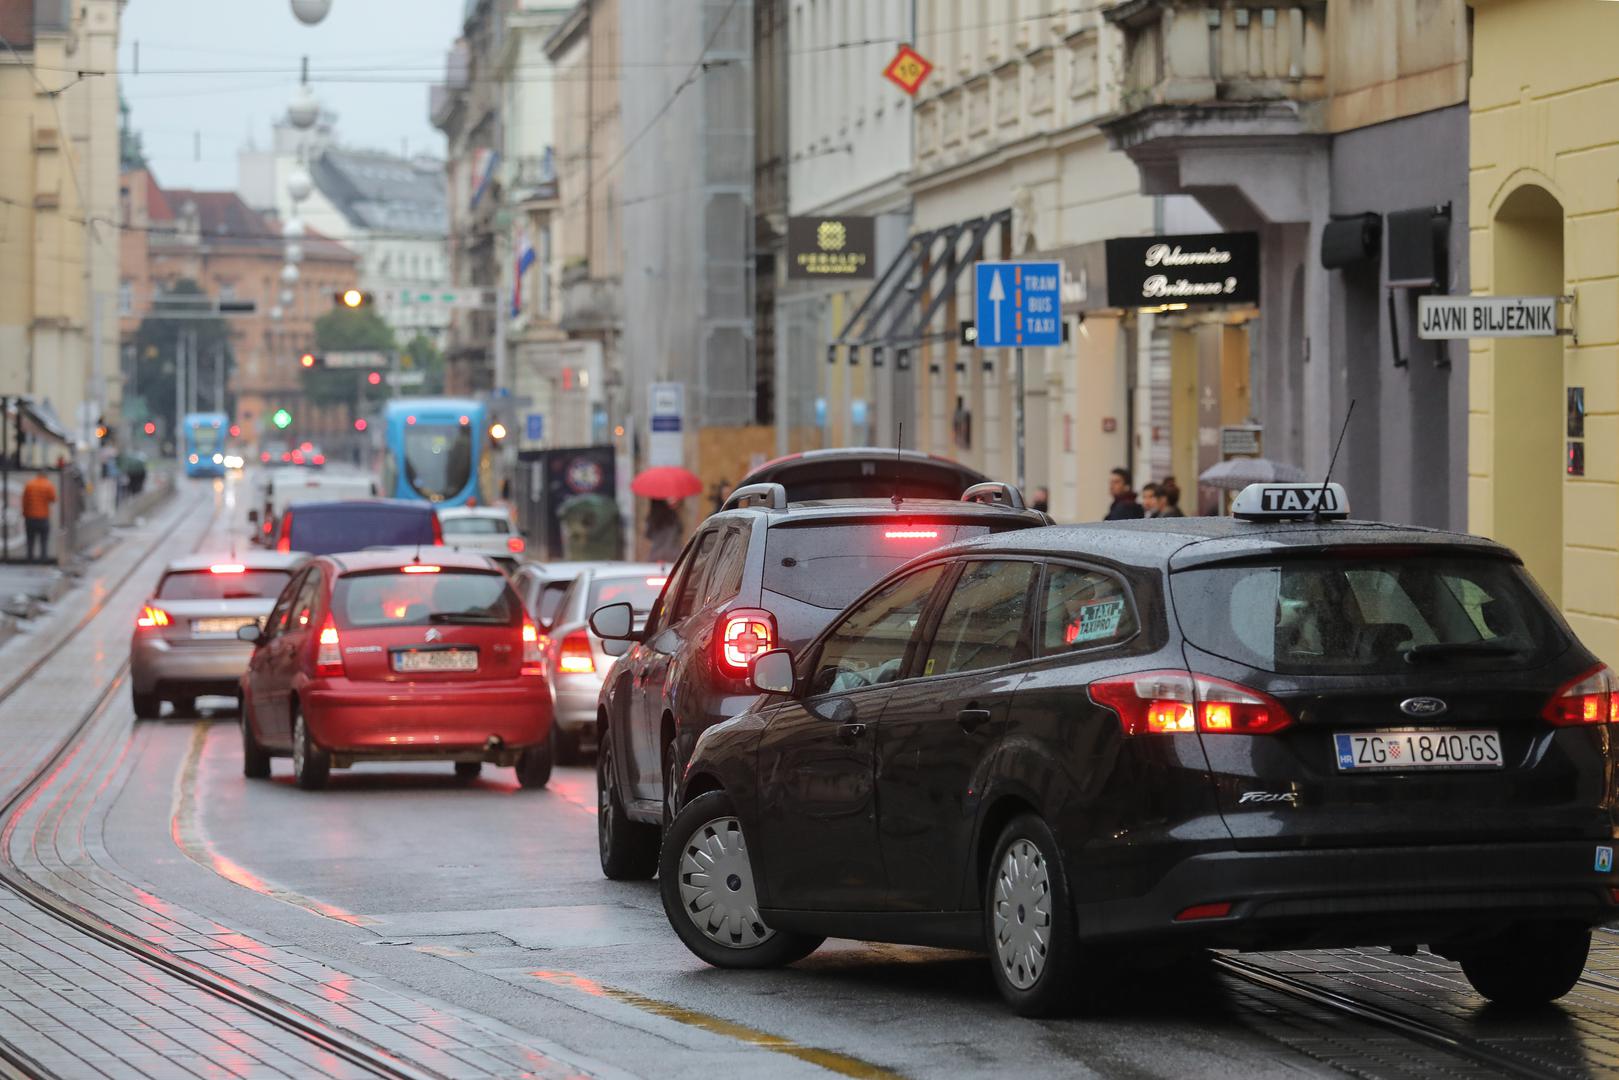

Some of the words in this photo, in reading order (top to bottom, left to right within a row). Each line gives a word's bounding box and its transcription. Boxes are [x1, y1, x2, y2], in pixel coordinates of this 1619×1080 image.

[900, 62, 920, 77] 10
[1025, 275, 1056, 291] TRAM
[1223, 276, 1237, 294] 2
[1028, 297, 1052, 312] BUS
[1423, 307, 1467, 331] JAVNI
[1473, 299, 1552, 331] BILJEŽNIK
[1027, 317, 1055, 334] TAXI
[1264, 489, 1335, 510] TAXI
[1092, 603, 1113, 621] TAXI
[1411, 700, 1437, 711] Ford
[1340, 755, 1353, 763] HR
[1354, 737, 1387, 763] ZG
